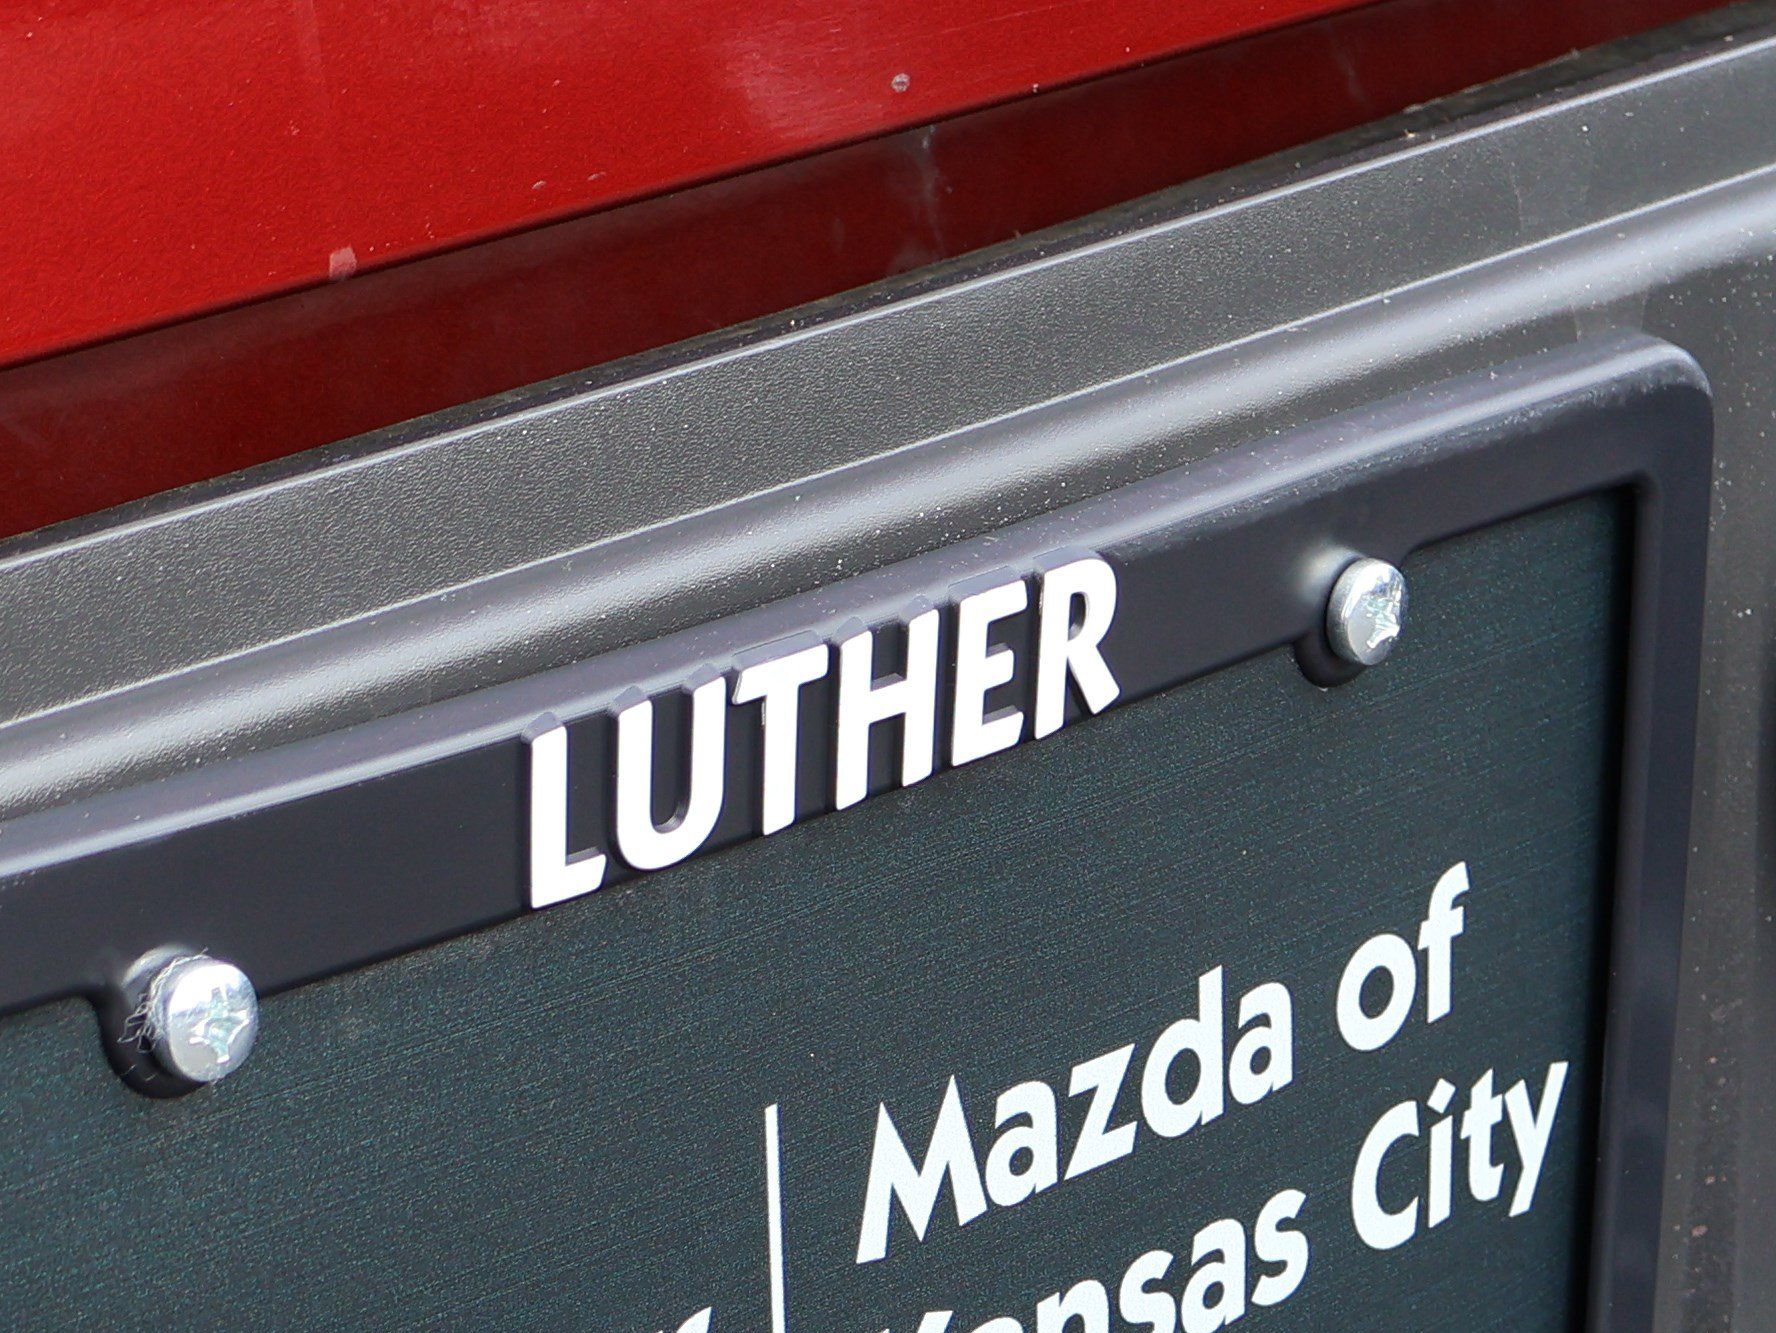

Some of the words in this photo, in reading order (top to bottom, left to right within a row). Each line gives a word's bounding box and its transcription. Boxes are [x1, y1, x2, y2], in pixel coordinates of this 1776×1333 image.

[526, 555, 1122, 910] LUTHER
[855, 965, 1293, 1265] Mazda
[1335, 861, 1470, 1053] of
[1351, 1061, 1569, 1251] City
